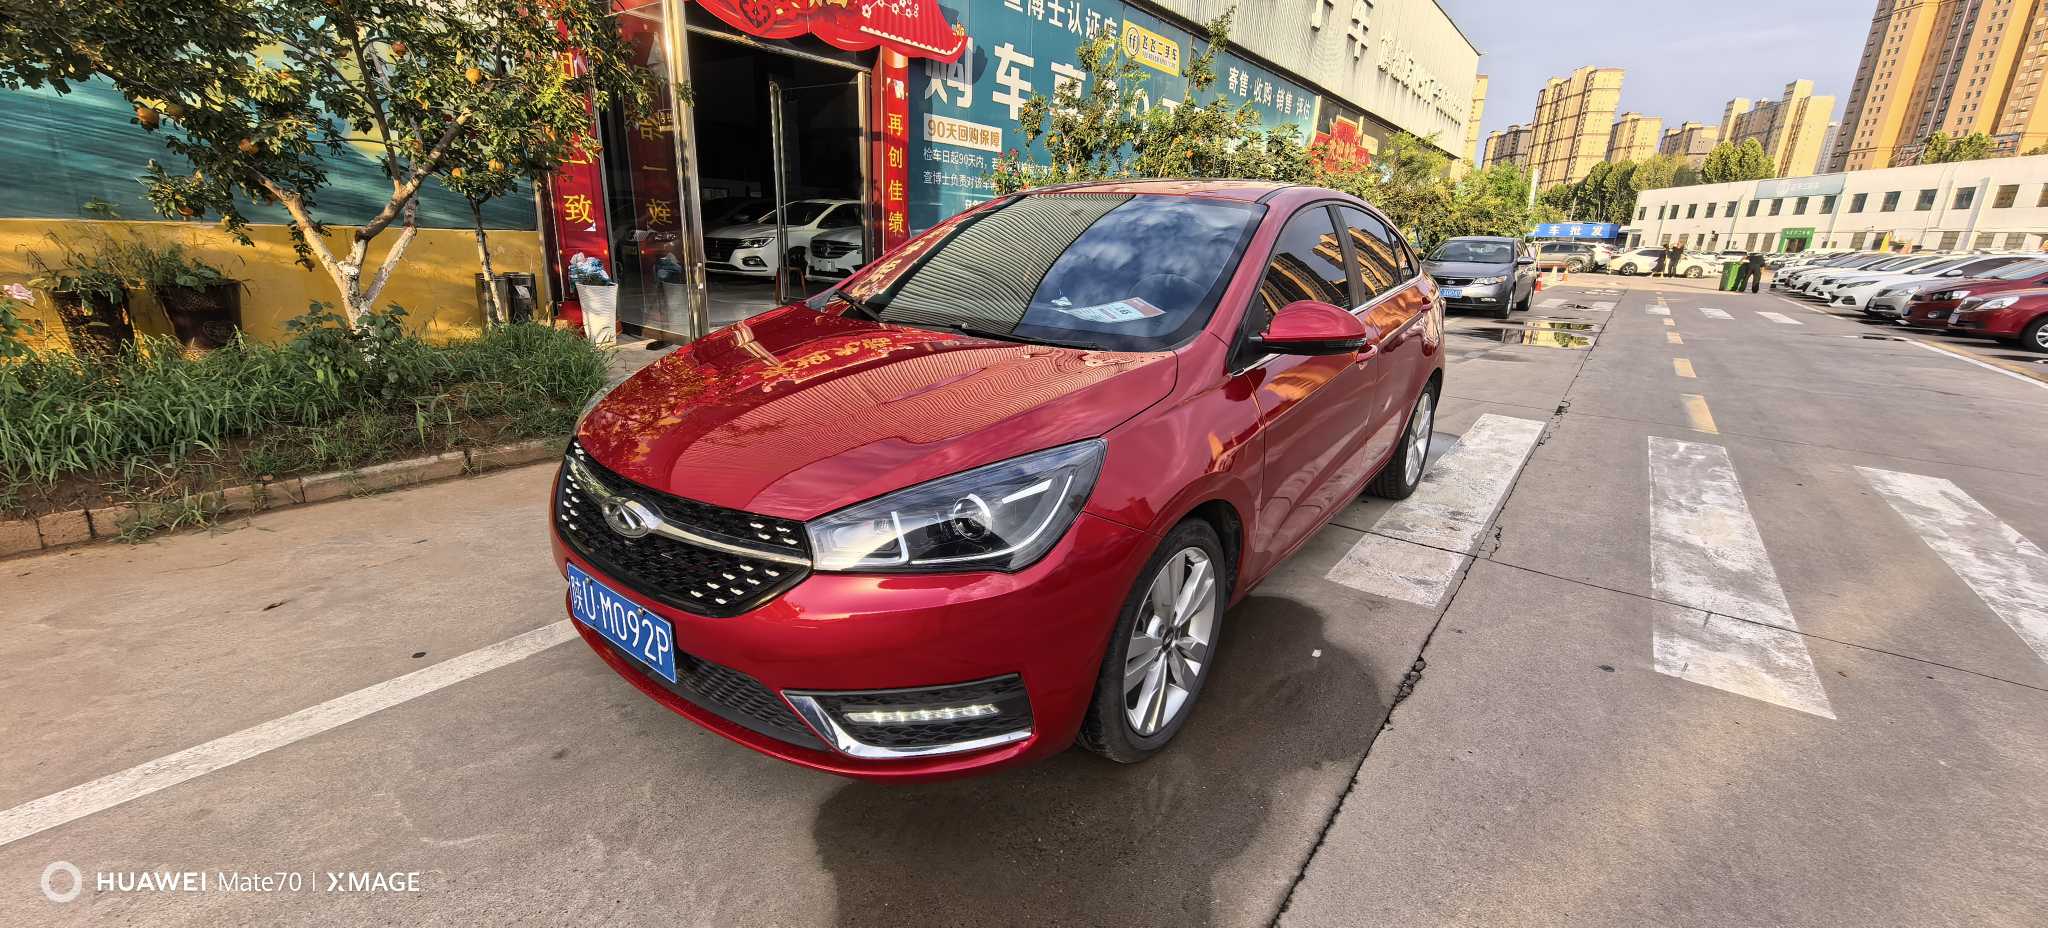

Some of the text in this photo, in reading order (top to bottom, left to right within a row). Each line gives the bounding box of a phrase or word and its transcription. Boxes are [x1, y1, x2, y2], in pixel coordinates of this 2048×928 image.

[927, 118, 1001, 148] 90天回购保障
[888, 112, 904, 234] 再创佳绩
